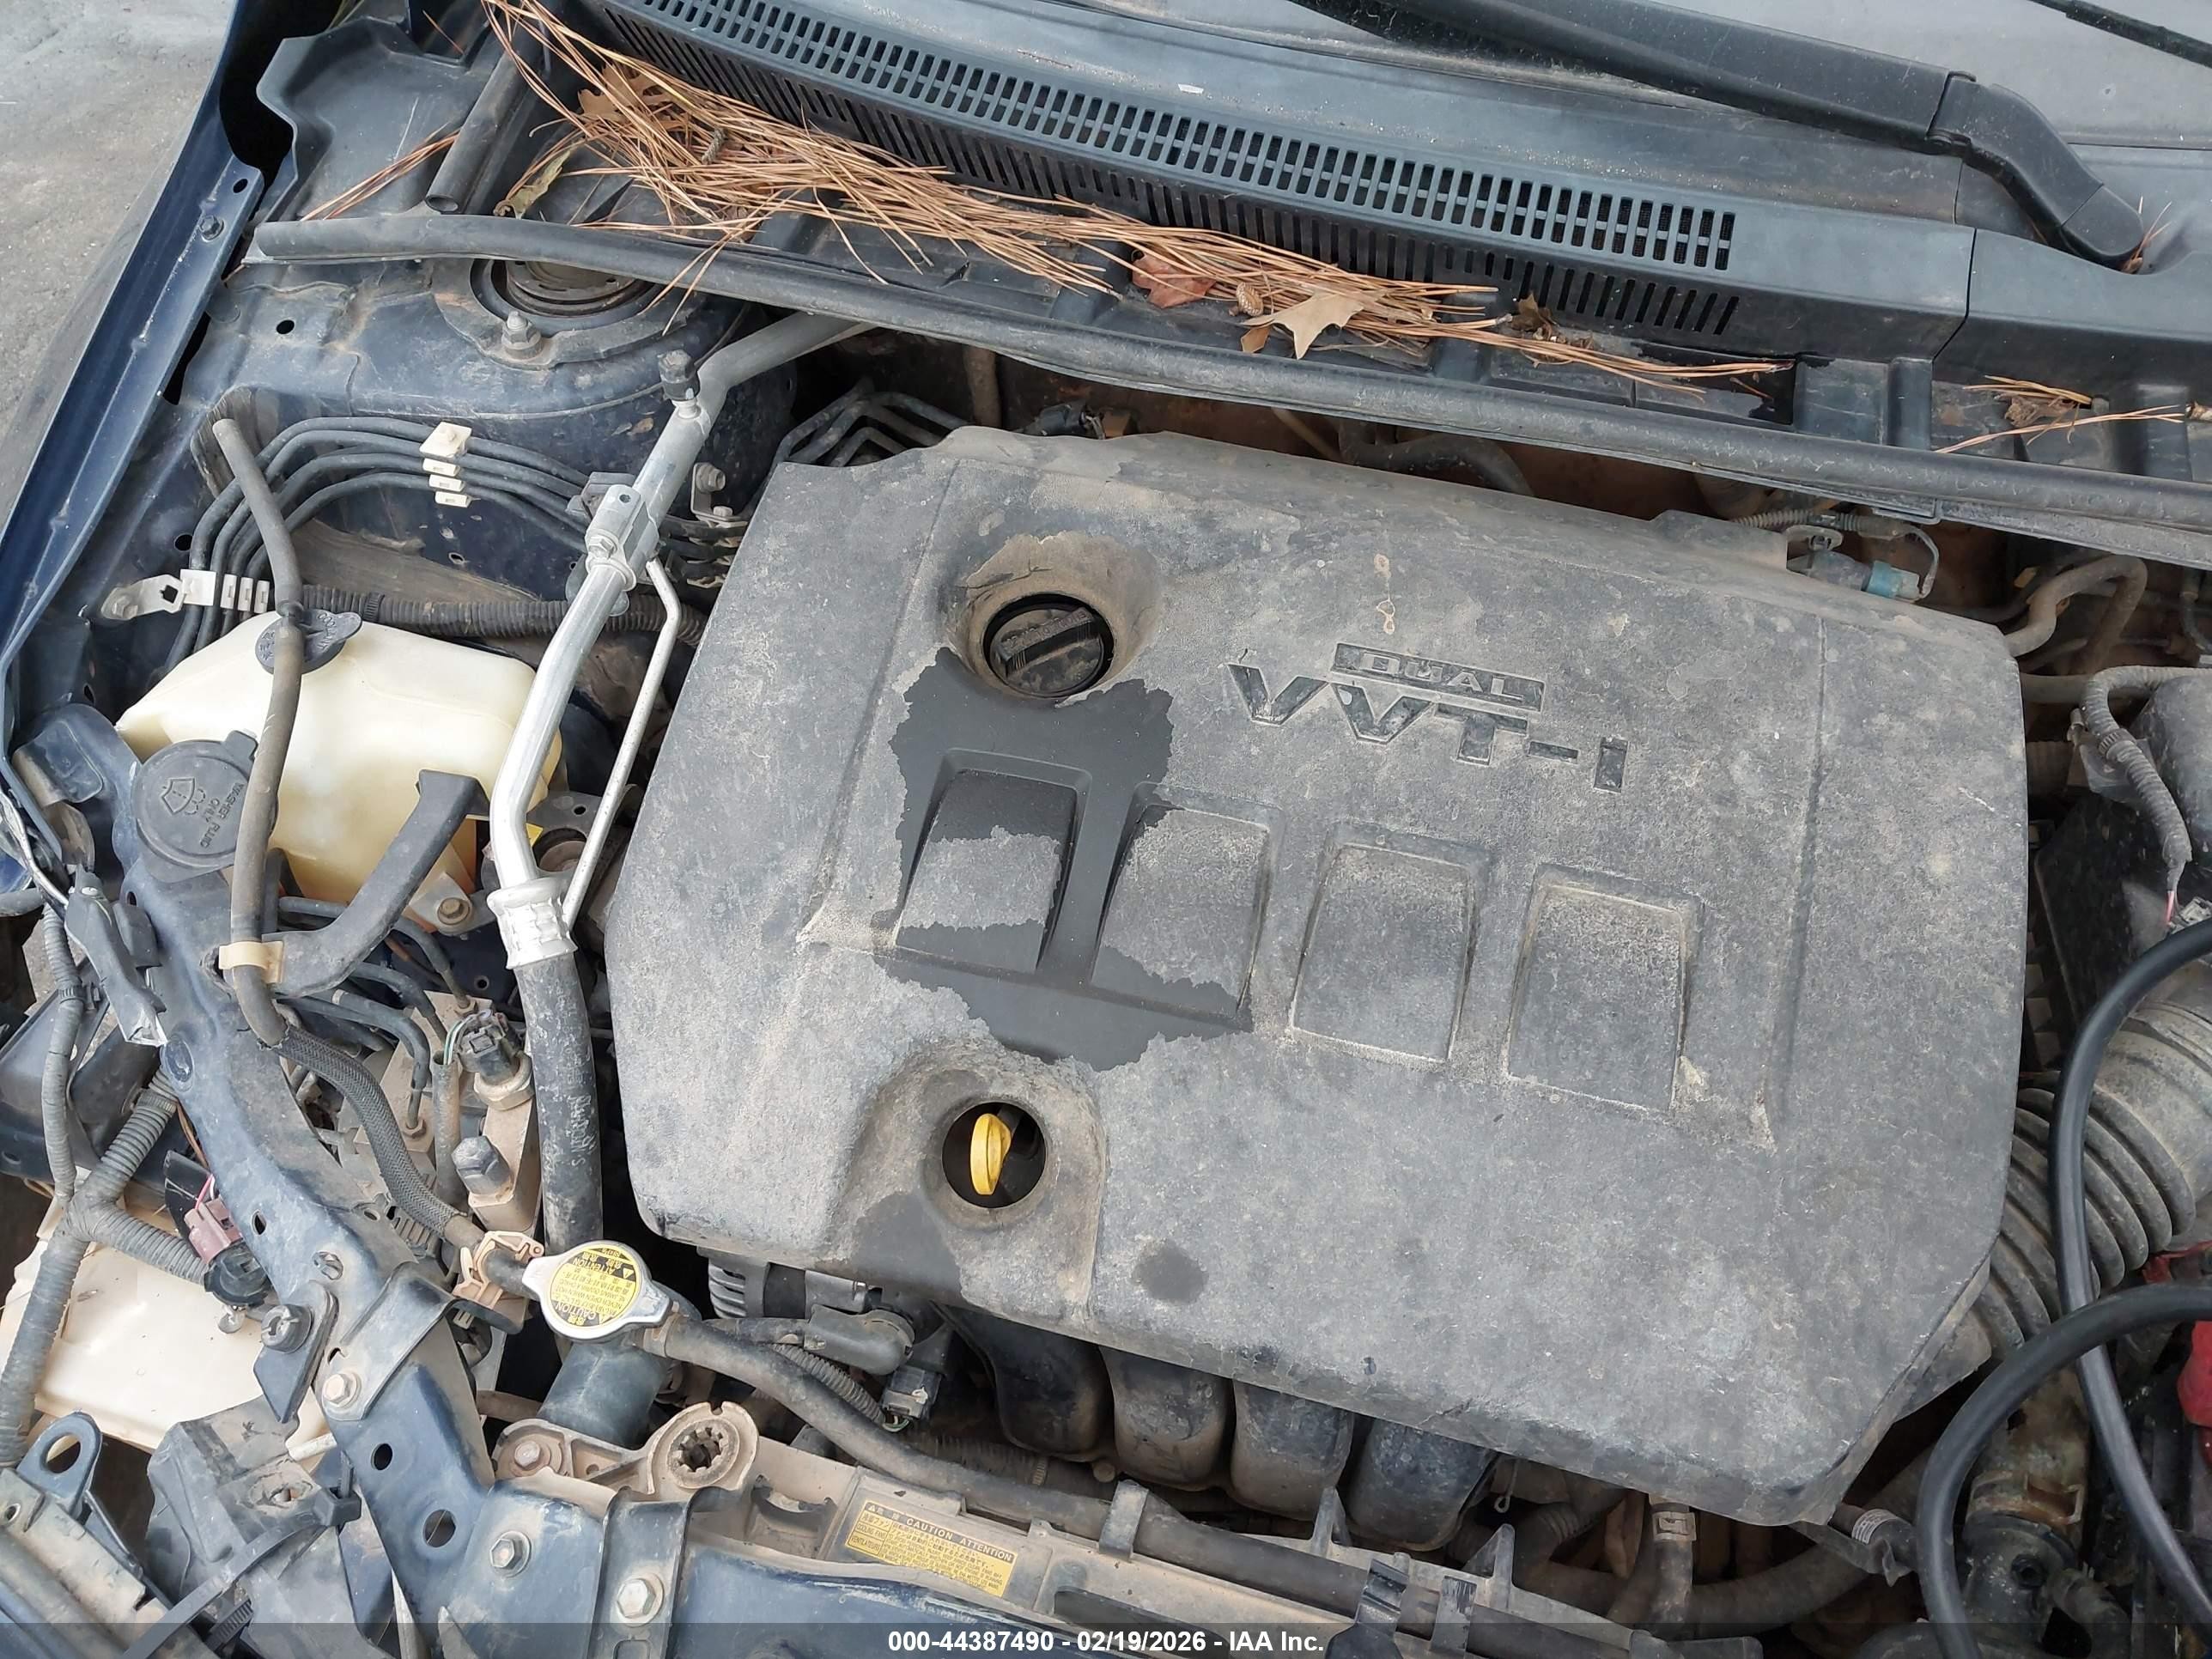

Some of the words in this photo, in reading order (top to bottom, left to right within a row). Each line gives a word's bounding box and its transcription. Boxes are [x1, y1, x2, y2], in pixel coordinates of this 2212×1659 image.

[1359, 651, 1525, 702] DUAL
[572, 1257, 615, 1276] ATTENTION
[555, 1301, 597, 1321] CAUTION
[906, 1518, 953, 1540] CAUTION
[960, 1536, 1013, 1562] ATTENTION
